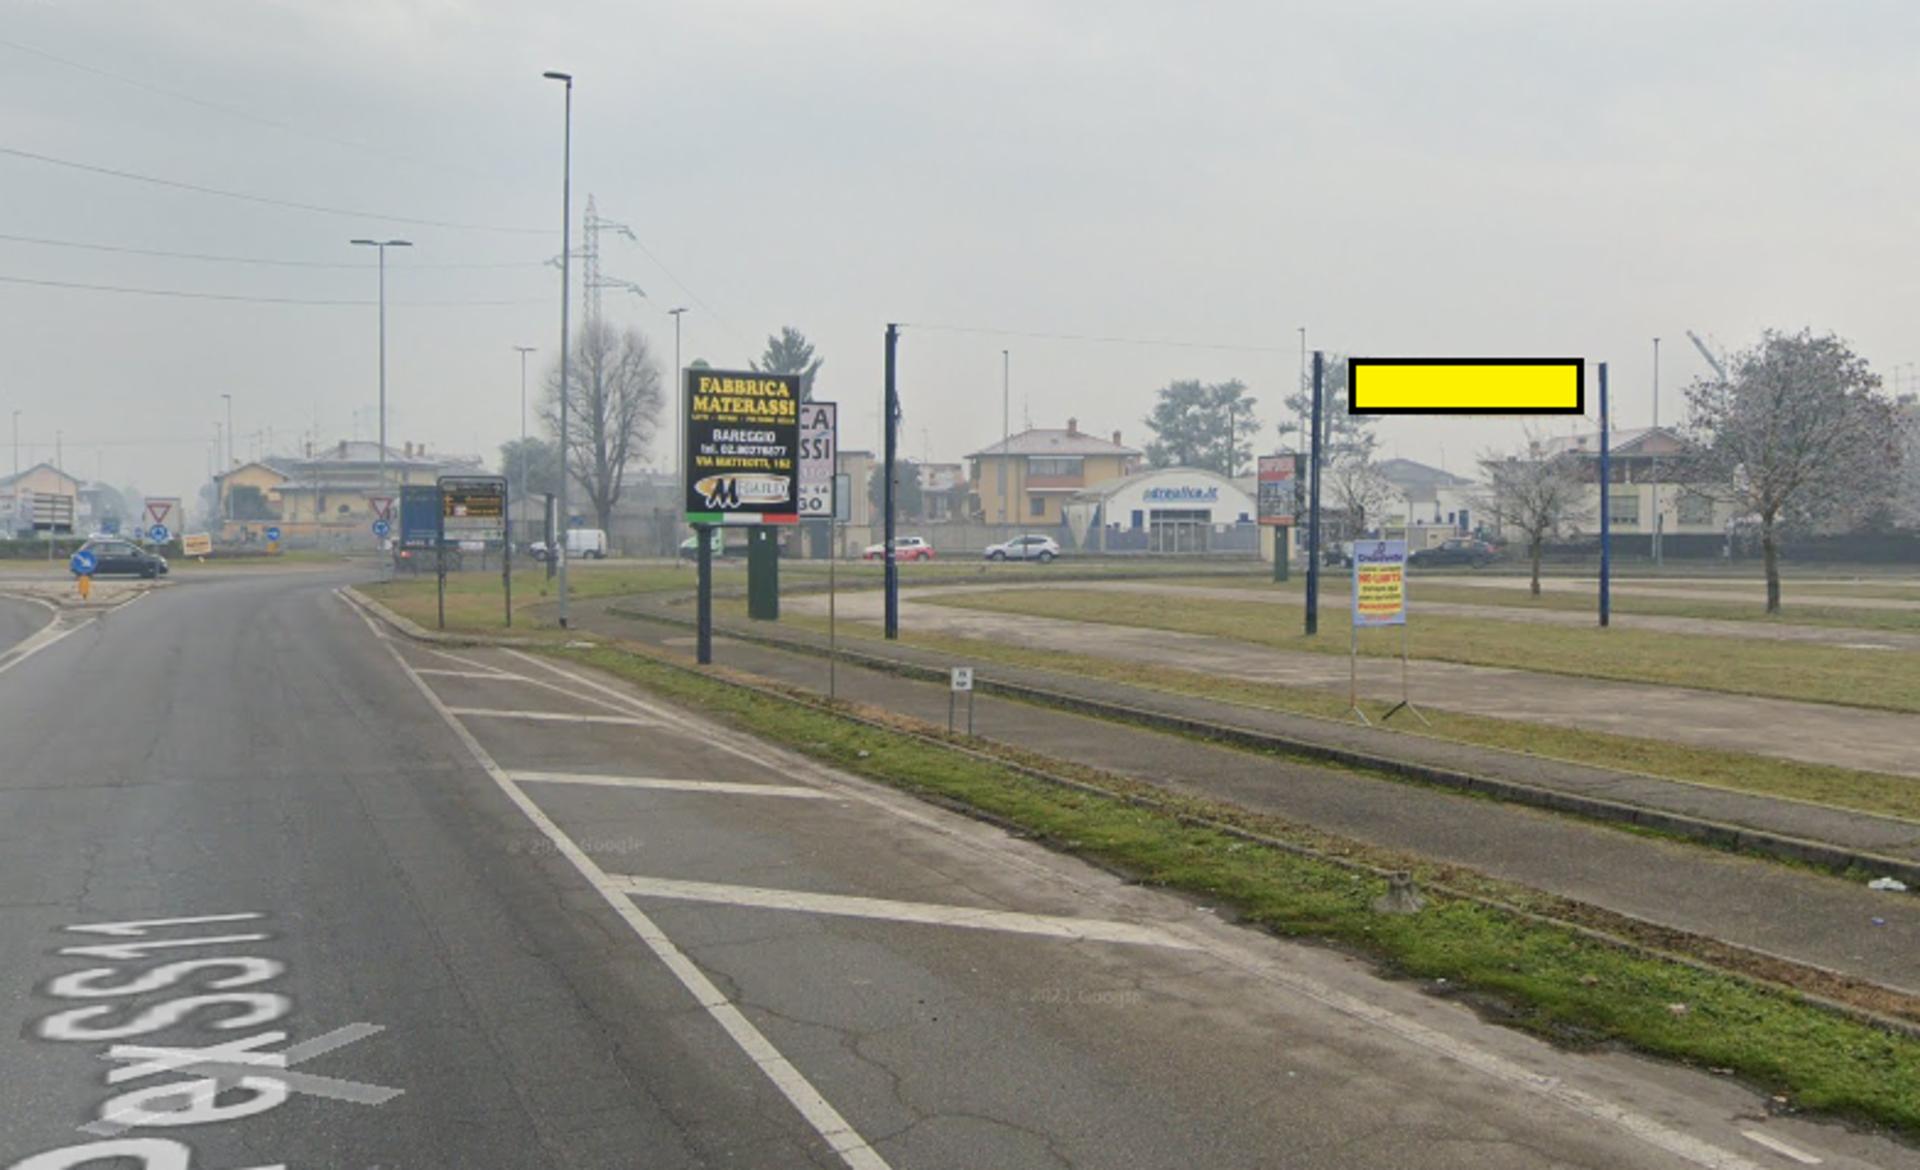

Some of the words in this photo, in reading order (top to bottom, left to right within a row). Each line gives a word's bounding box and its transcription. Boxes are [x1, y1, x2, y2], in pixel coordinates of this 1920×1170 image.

[699, 377, 789, 397] FABBRICA
[693, 395, 795, 415] MATERASSI
[713, 428, 775, 443] BAREGGIO
